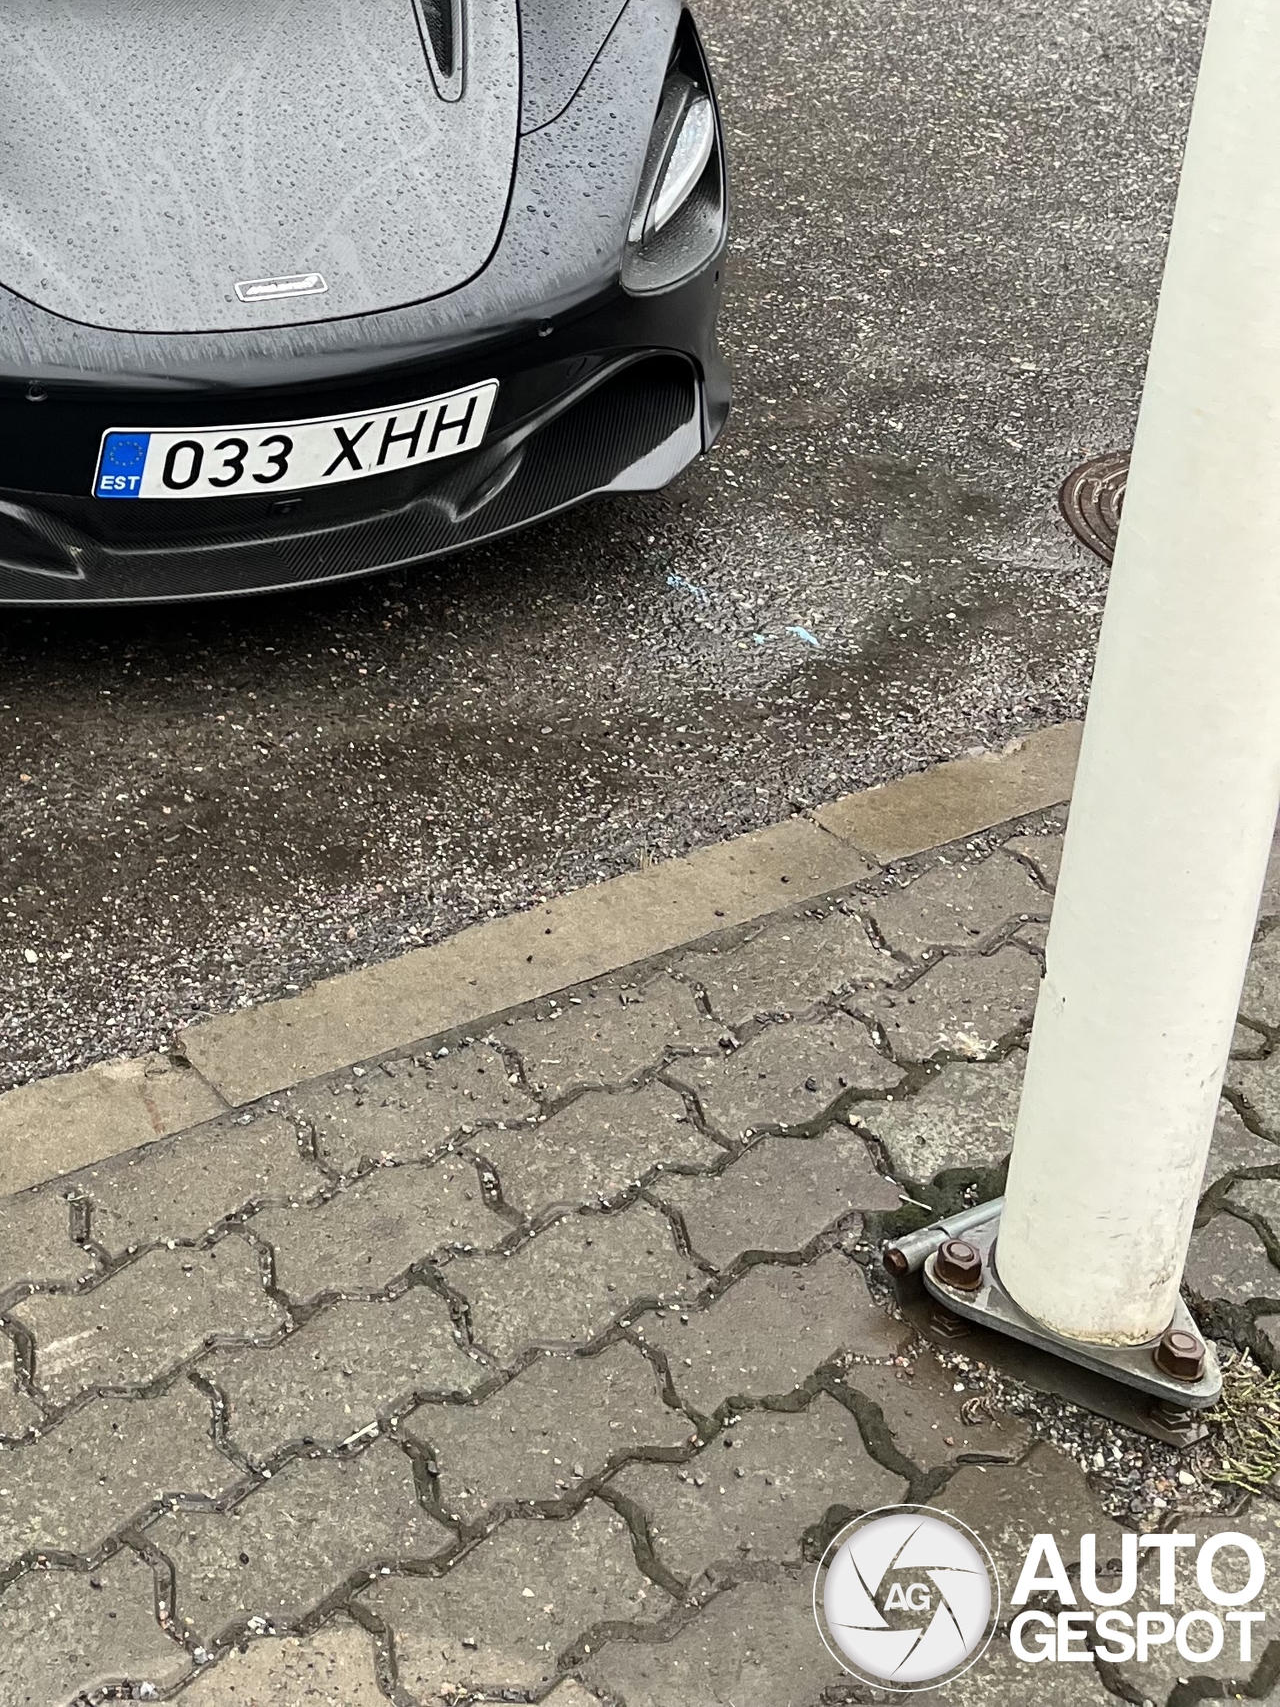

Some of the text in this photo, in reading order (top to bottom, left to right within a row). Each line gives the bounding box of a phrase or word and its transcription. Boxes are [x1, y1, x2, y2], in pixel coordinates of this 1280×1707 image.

[162, 396, 479, 491] 033 XHH
[100, 475, 141, 490] EST
